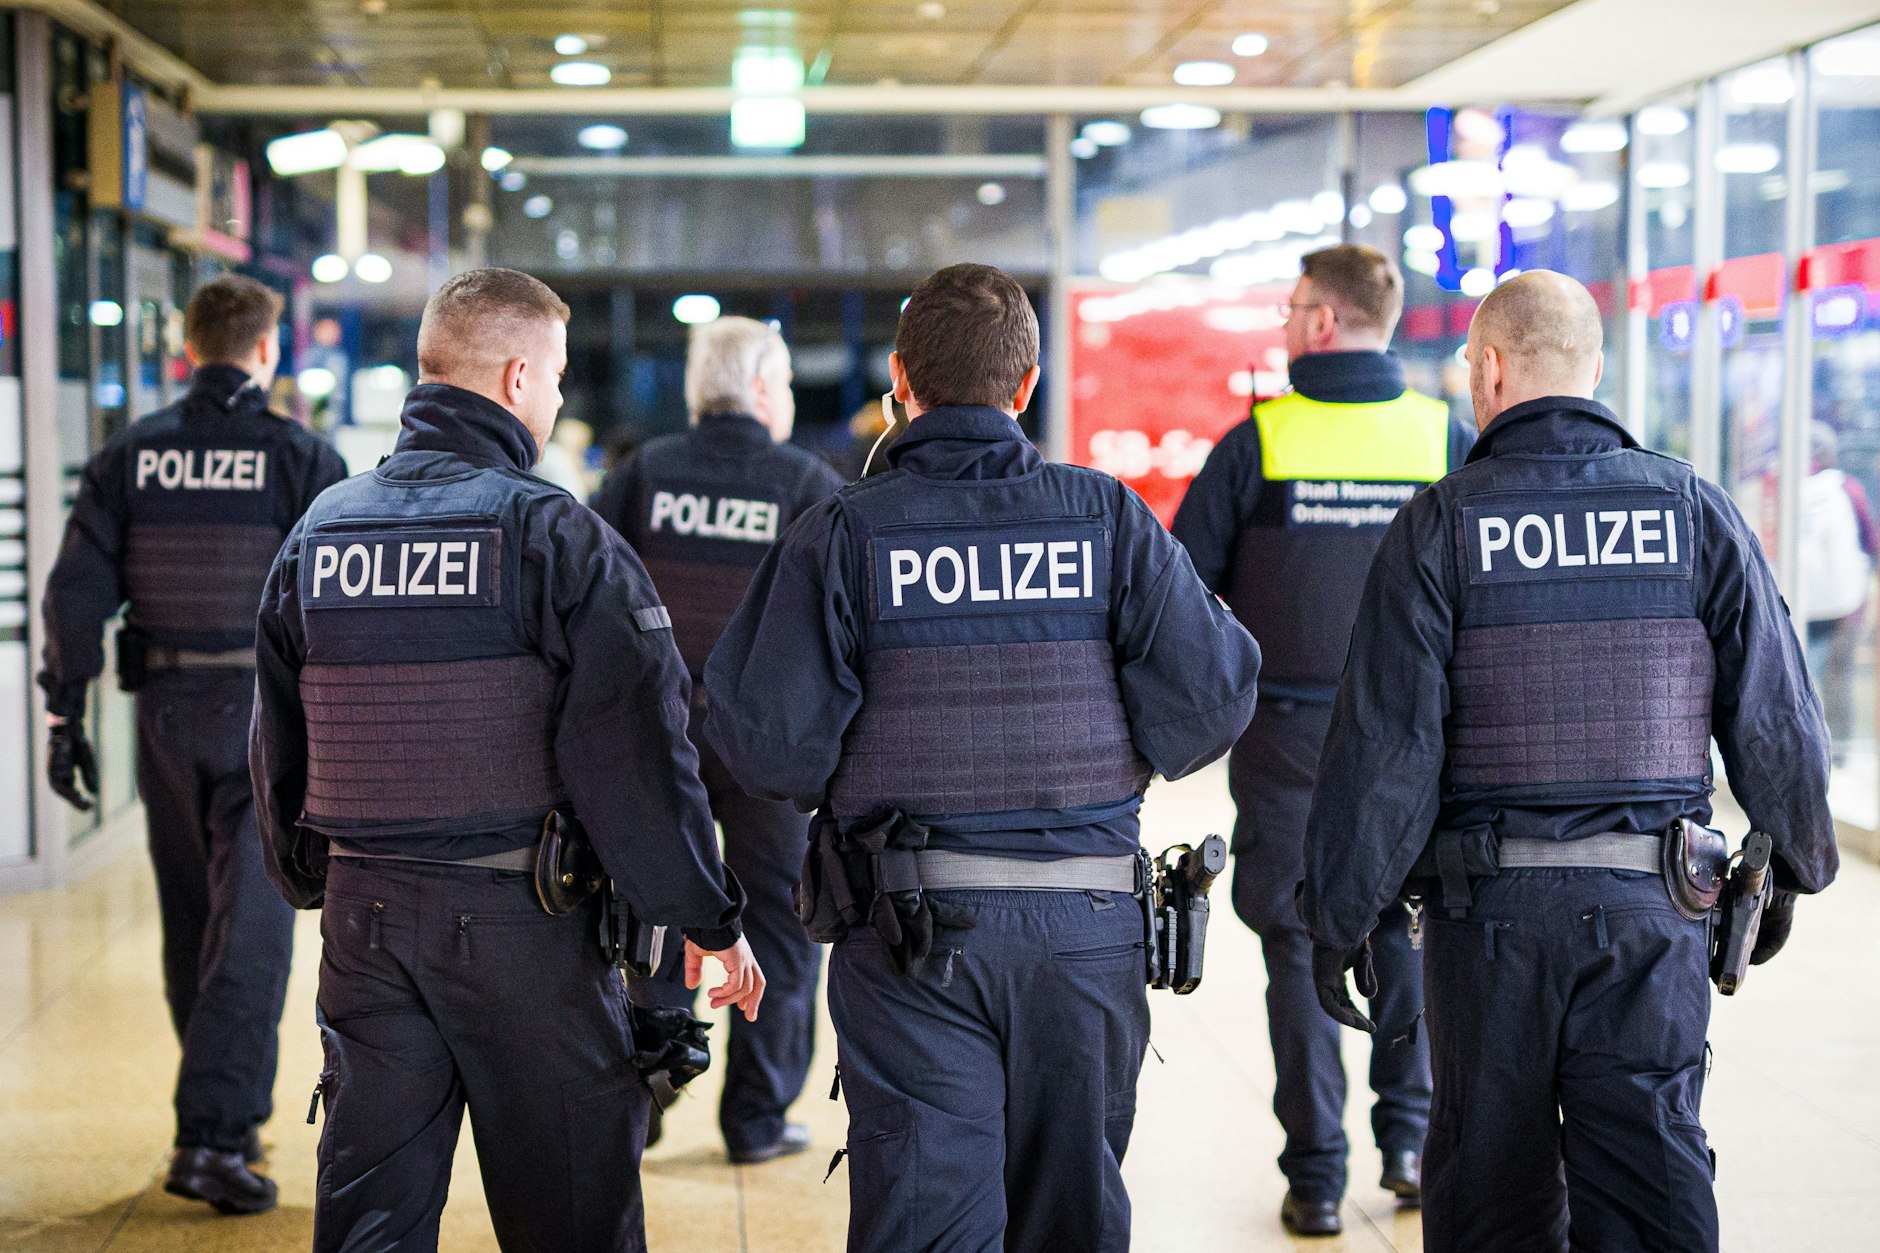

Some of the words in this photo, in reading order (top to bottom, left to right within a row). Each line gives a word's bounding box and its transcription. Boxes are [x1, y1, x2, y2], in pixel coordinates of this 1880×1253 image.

[136, 448, 266, 490] POLIZEI
[1294, 481, 1339, 500] Stadt
[651, 491, 780, 542] POLIZEI
[1478, 509, 1678, 572] POLIZEI
[312, 541, 480, 598] POLIZEI
[889, 540, 1093, 607] POLIZEI
